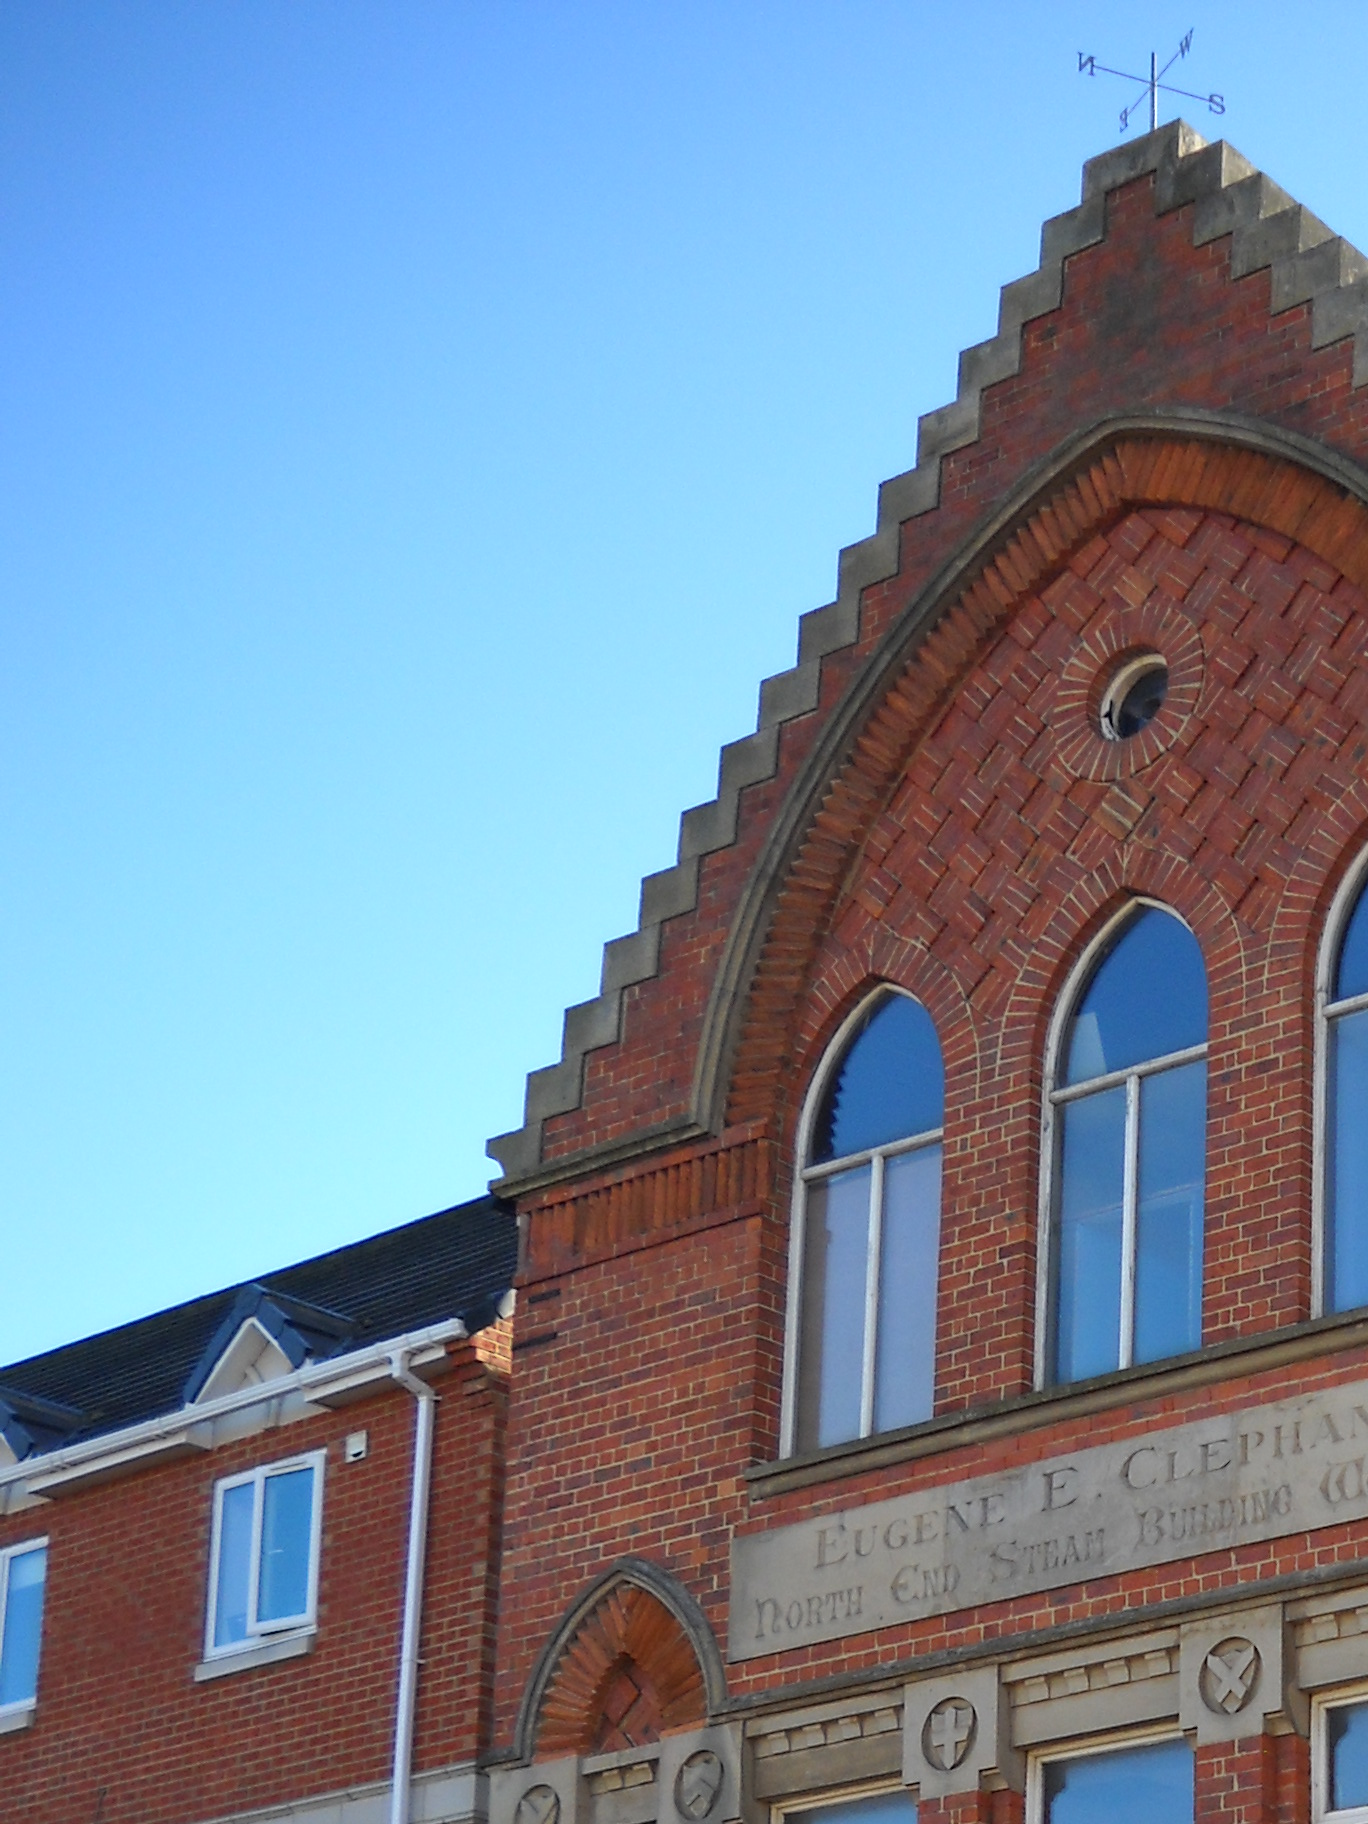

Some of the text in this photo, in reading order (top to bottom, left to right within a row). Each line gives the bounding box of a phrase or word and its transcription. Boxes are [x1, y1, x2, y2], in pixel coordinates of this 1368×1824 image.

[1209, 94, 1226, 115] S
[754, 1586, 864, 1639] NORTH
[891, 1563, 962, 1605] END
[989, 1528, 1106, 1584] STEAM
[1133, 1483, 1294, 1553] BUILDING
[813, 1492, 1005, 1570] EUGENE
